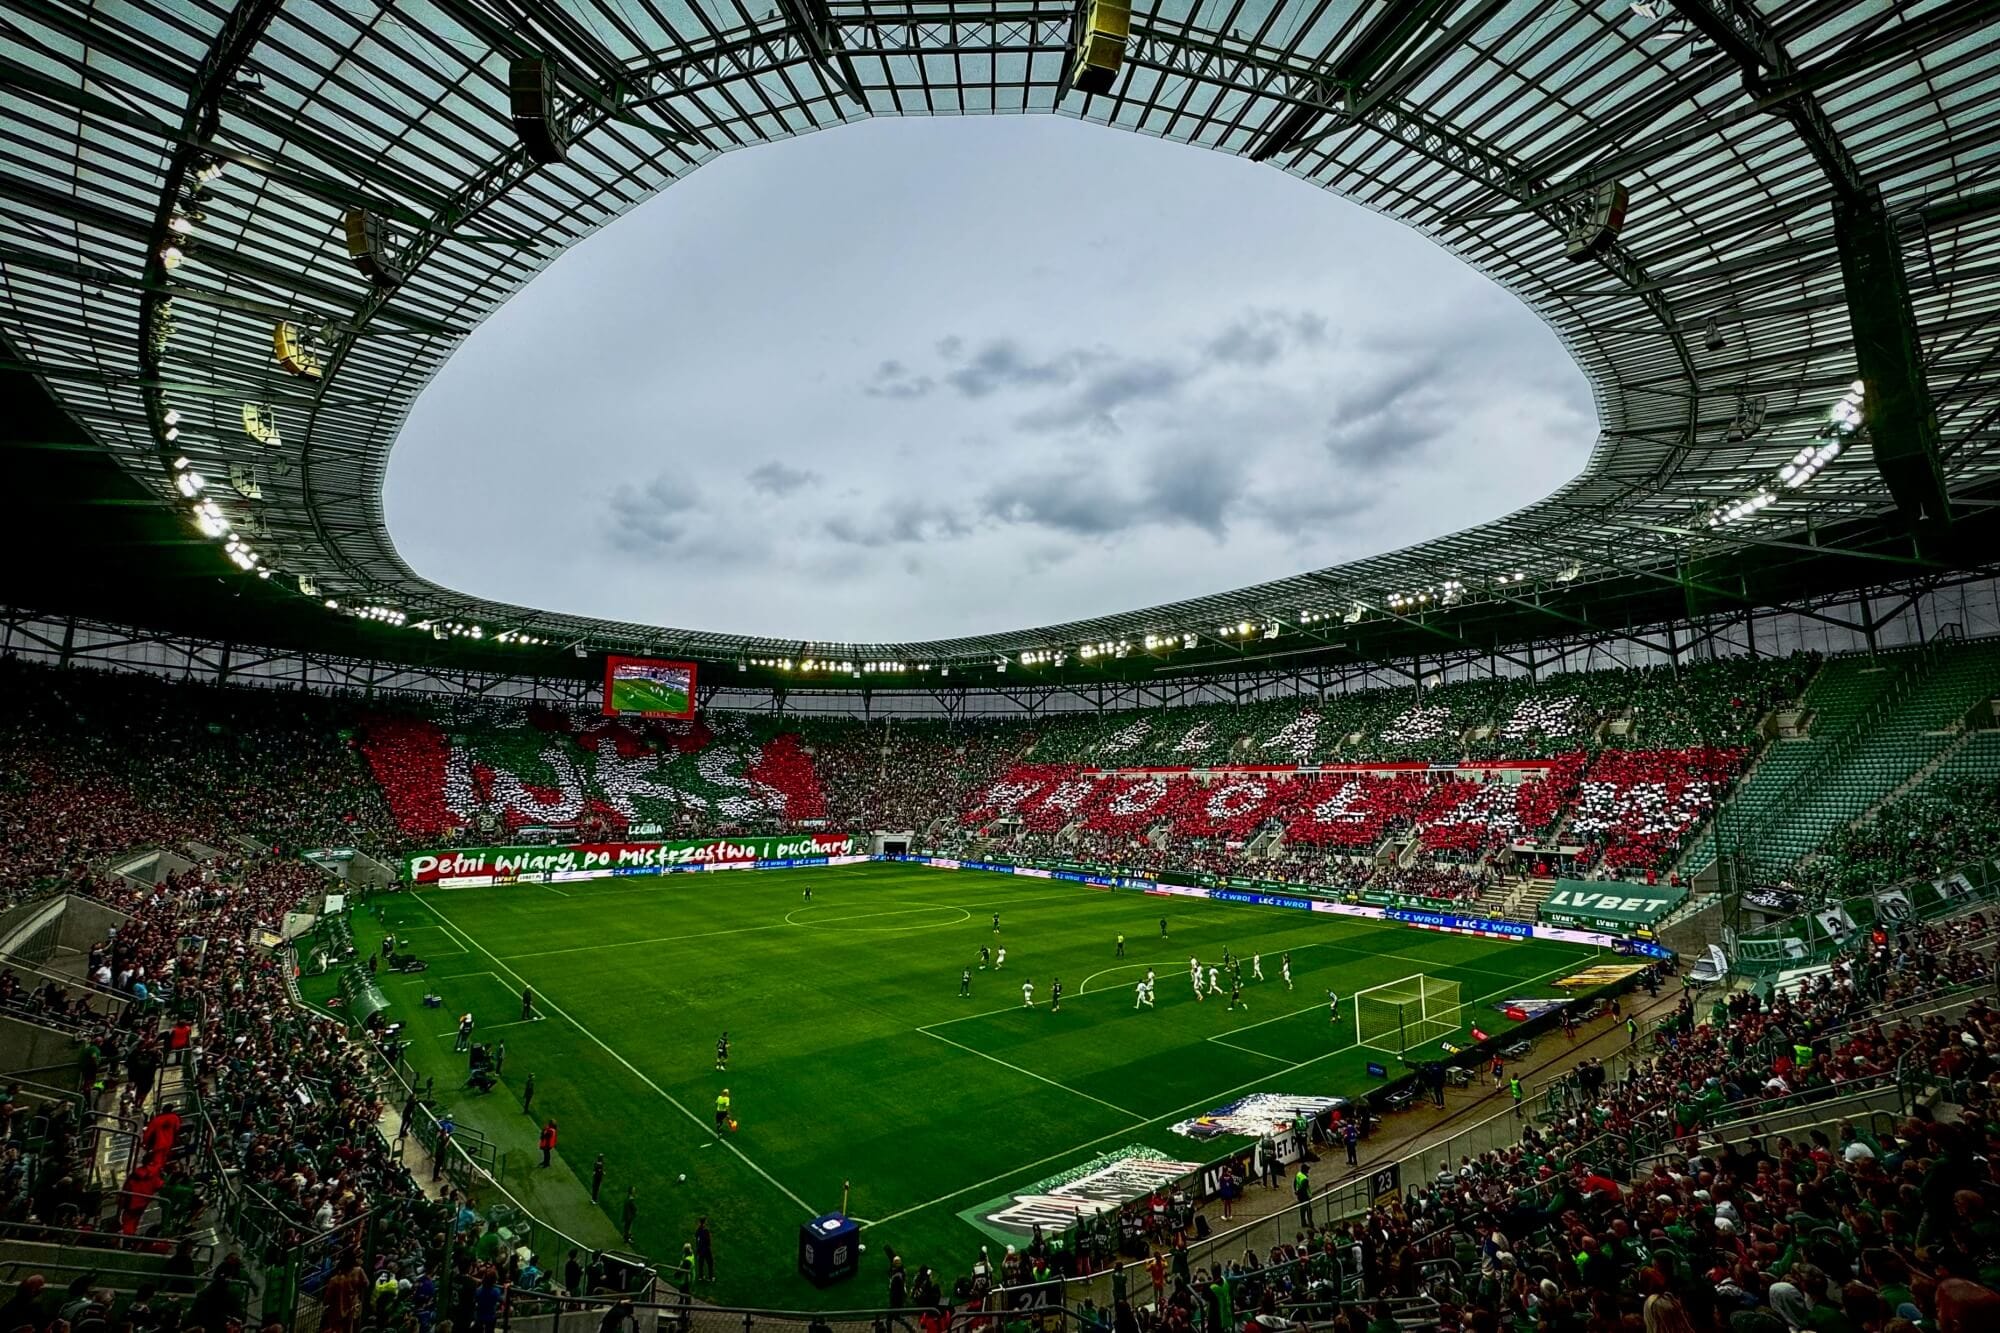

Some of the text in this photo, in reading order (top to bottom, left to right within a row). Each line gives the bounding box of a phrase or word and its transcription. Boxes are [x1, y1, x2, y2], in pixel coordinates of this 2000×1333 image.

[411, 853, 486, 879] Pełni
[582, 851, 610, 869] po
[763, 843, 770, 858] i
[1229, 893, 1251, 902] WRO!
[1259, 896, 1274, 906] LEĆ
[1283, 900, 1307, 909] WRO!
[1550, 891, 1668, 913] LVBET
[1413, 914, 1444, 925] WRO!
[1552, 914, 1574, 922] LVBET
[1596, 919, 1619, 928] LVBET
[1456, 918, 1527, 935] LEĆ Z WRO!
[1378, 1170, 1392, 1194] 23
[1019, 1290, 1047, 1311] 24
